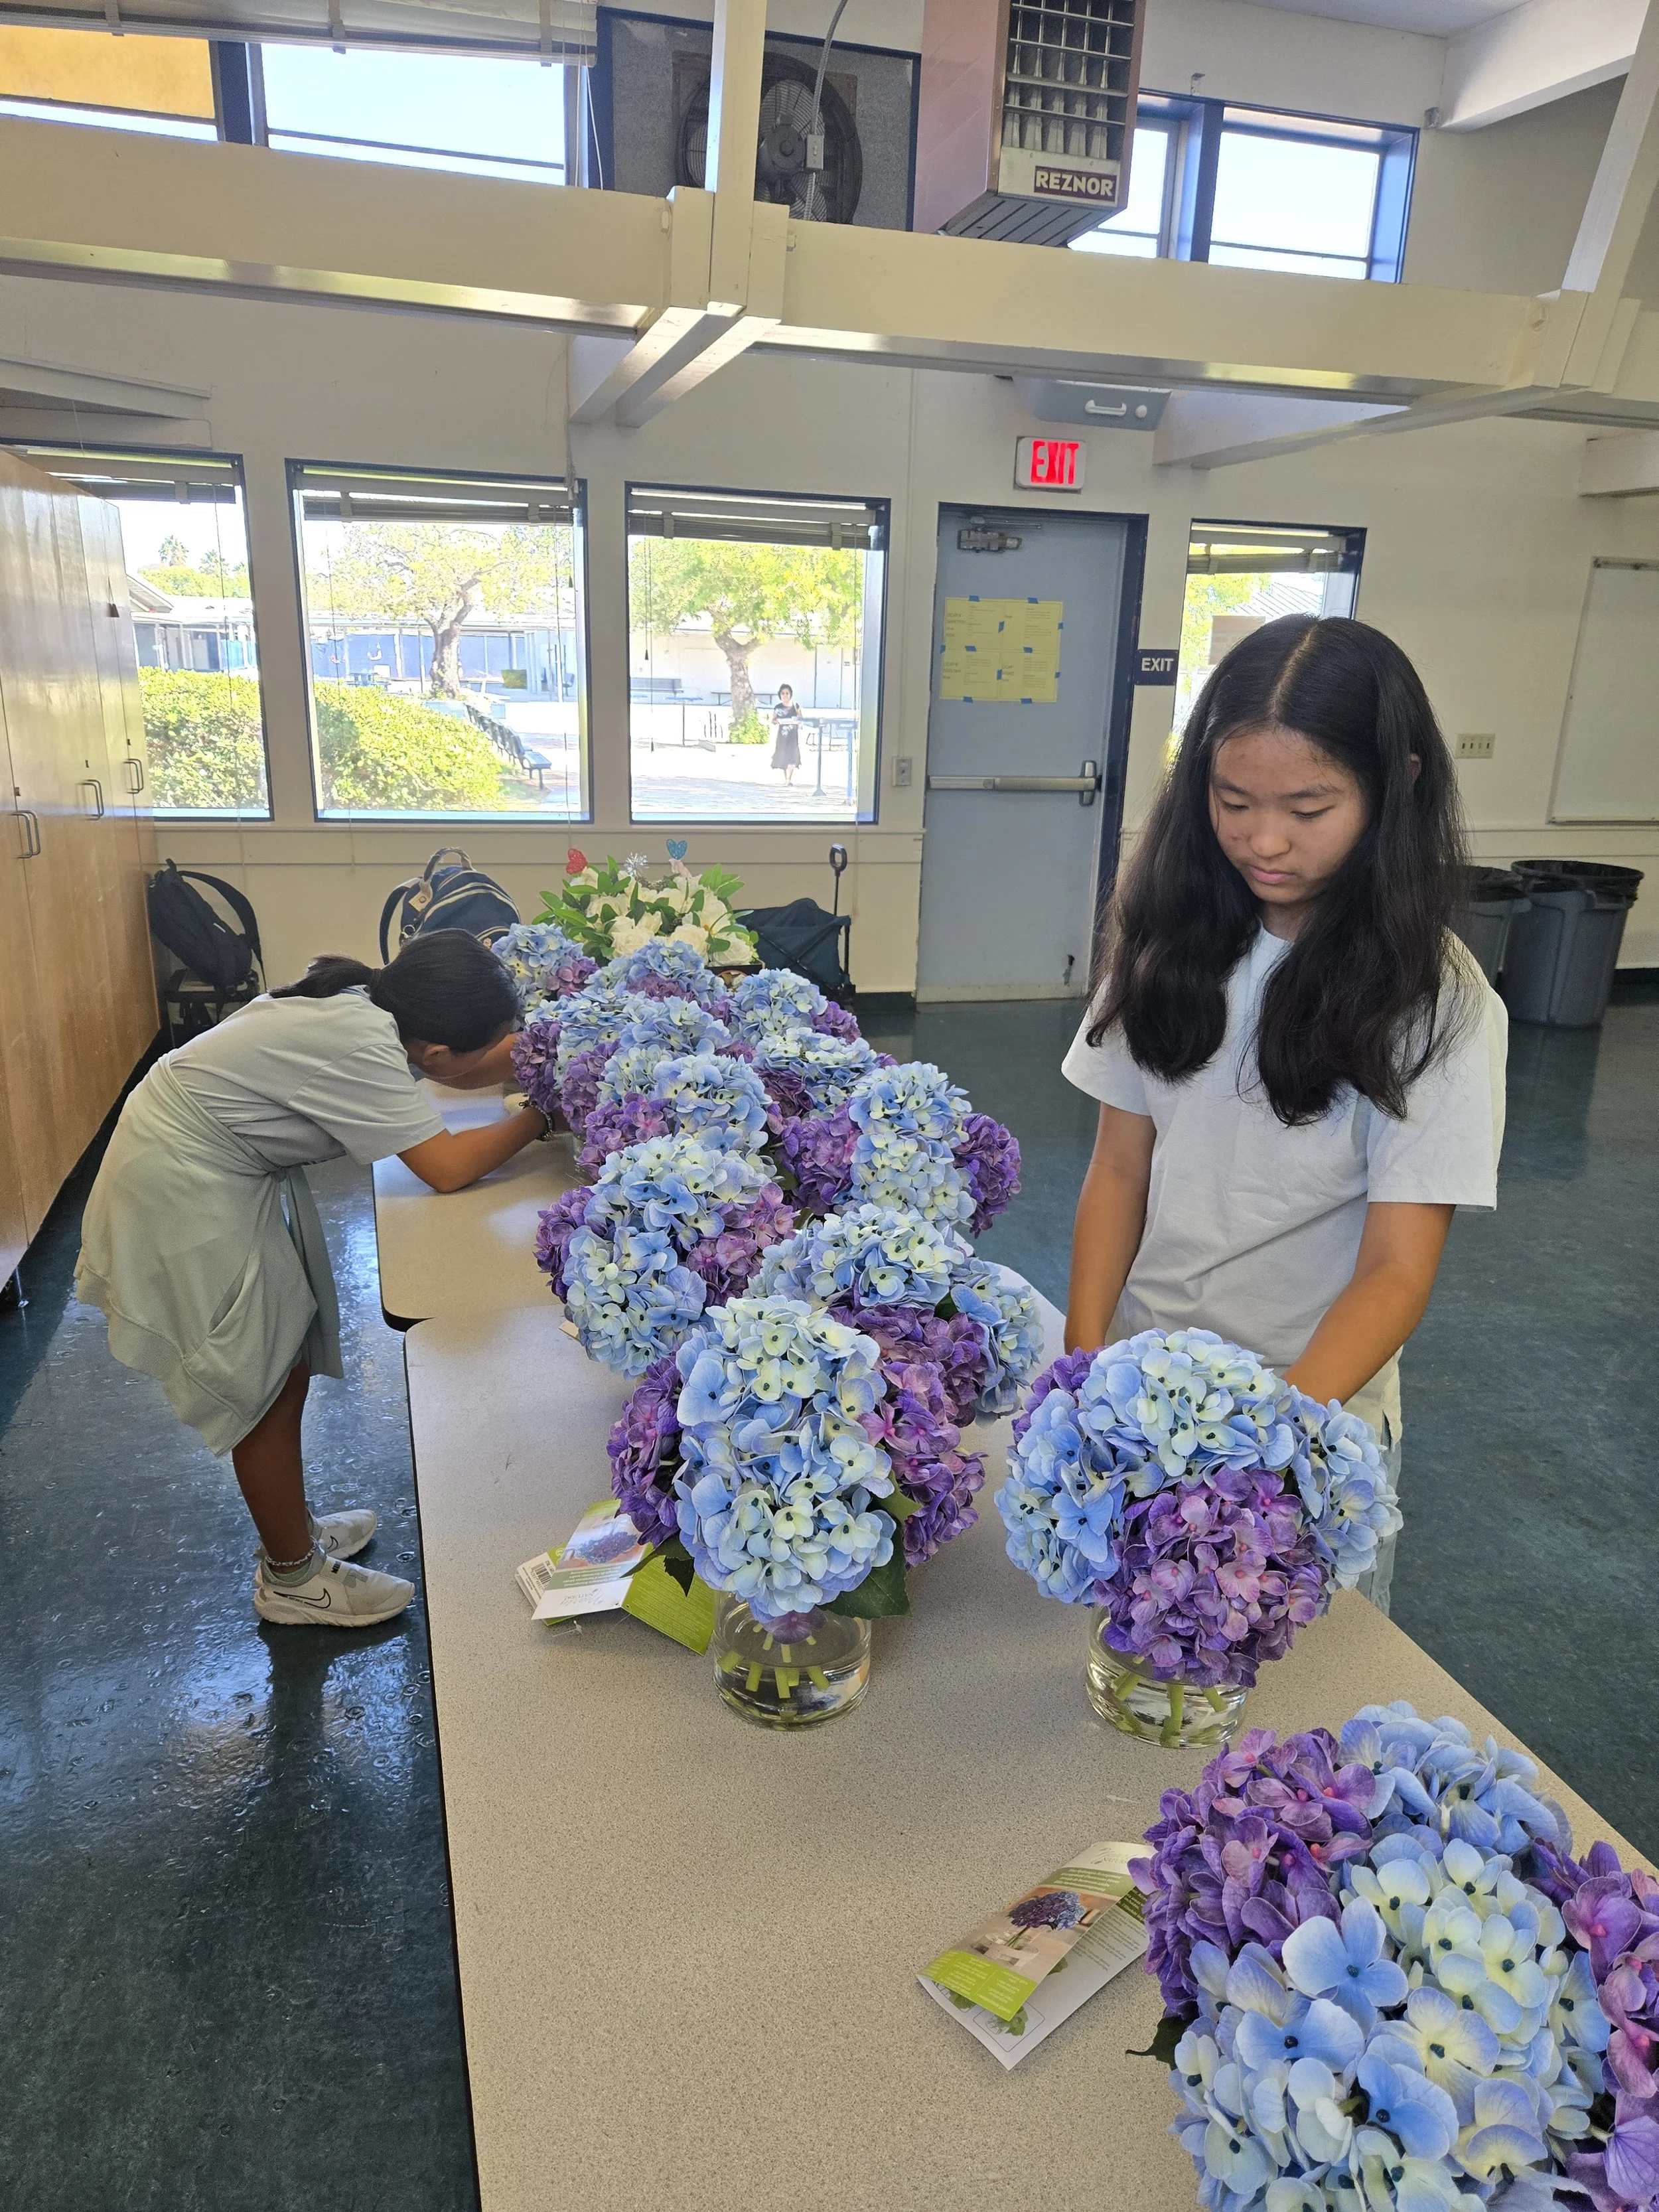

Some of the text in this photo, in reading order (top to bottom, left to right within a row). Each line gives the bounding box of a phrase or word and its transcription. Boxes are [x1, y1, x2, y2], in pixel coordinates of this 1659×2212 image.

[1036, 170, 1114, 196] REZNOR
[1031, 439, 1080, 485] EXIT
[1141, 657, 1174, 672] EXIT
